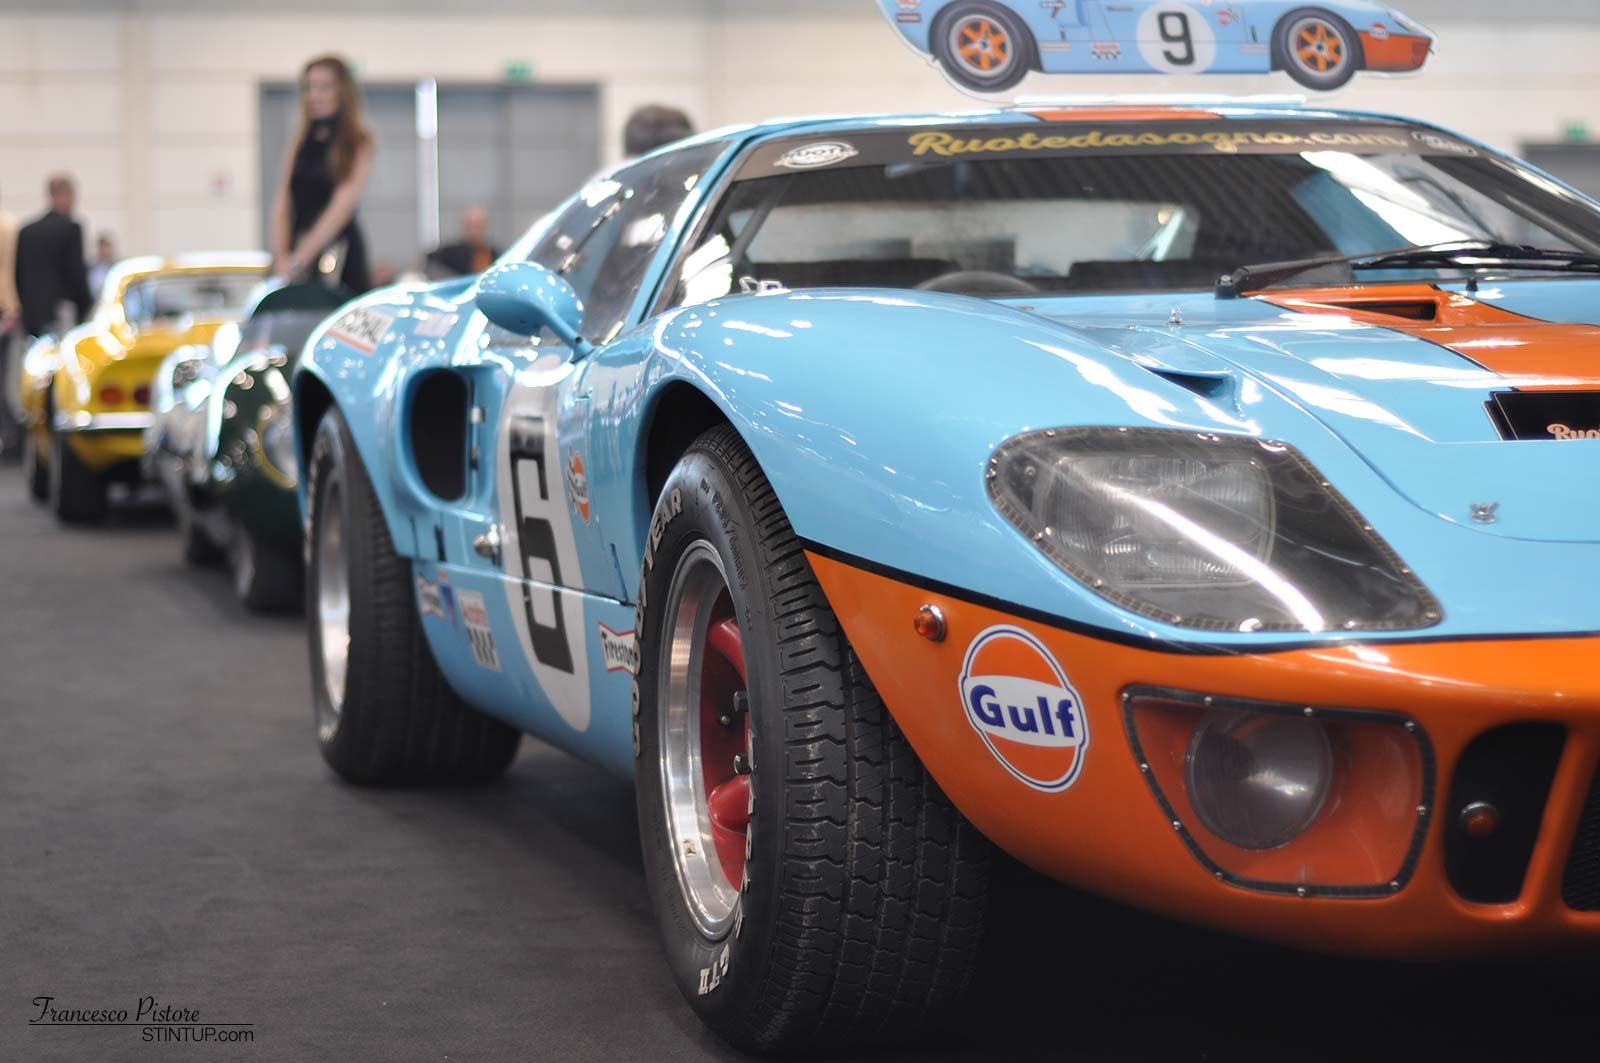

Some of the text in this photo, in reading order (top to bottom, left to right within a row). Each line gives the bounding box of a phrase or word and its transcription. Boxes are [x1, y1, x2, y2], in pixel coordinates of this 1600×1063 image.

[1157, 11, 1195, 66] 9
[908, 131, 1408, 153] Ruotedasogno.com
[1546, 423, 1600, 440] Ruo
[509, 416, 574, 675] 6
[601, 631, 635, 666] Fireston
[970, 684, 1075, 738] Gulf
